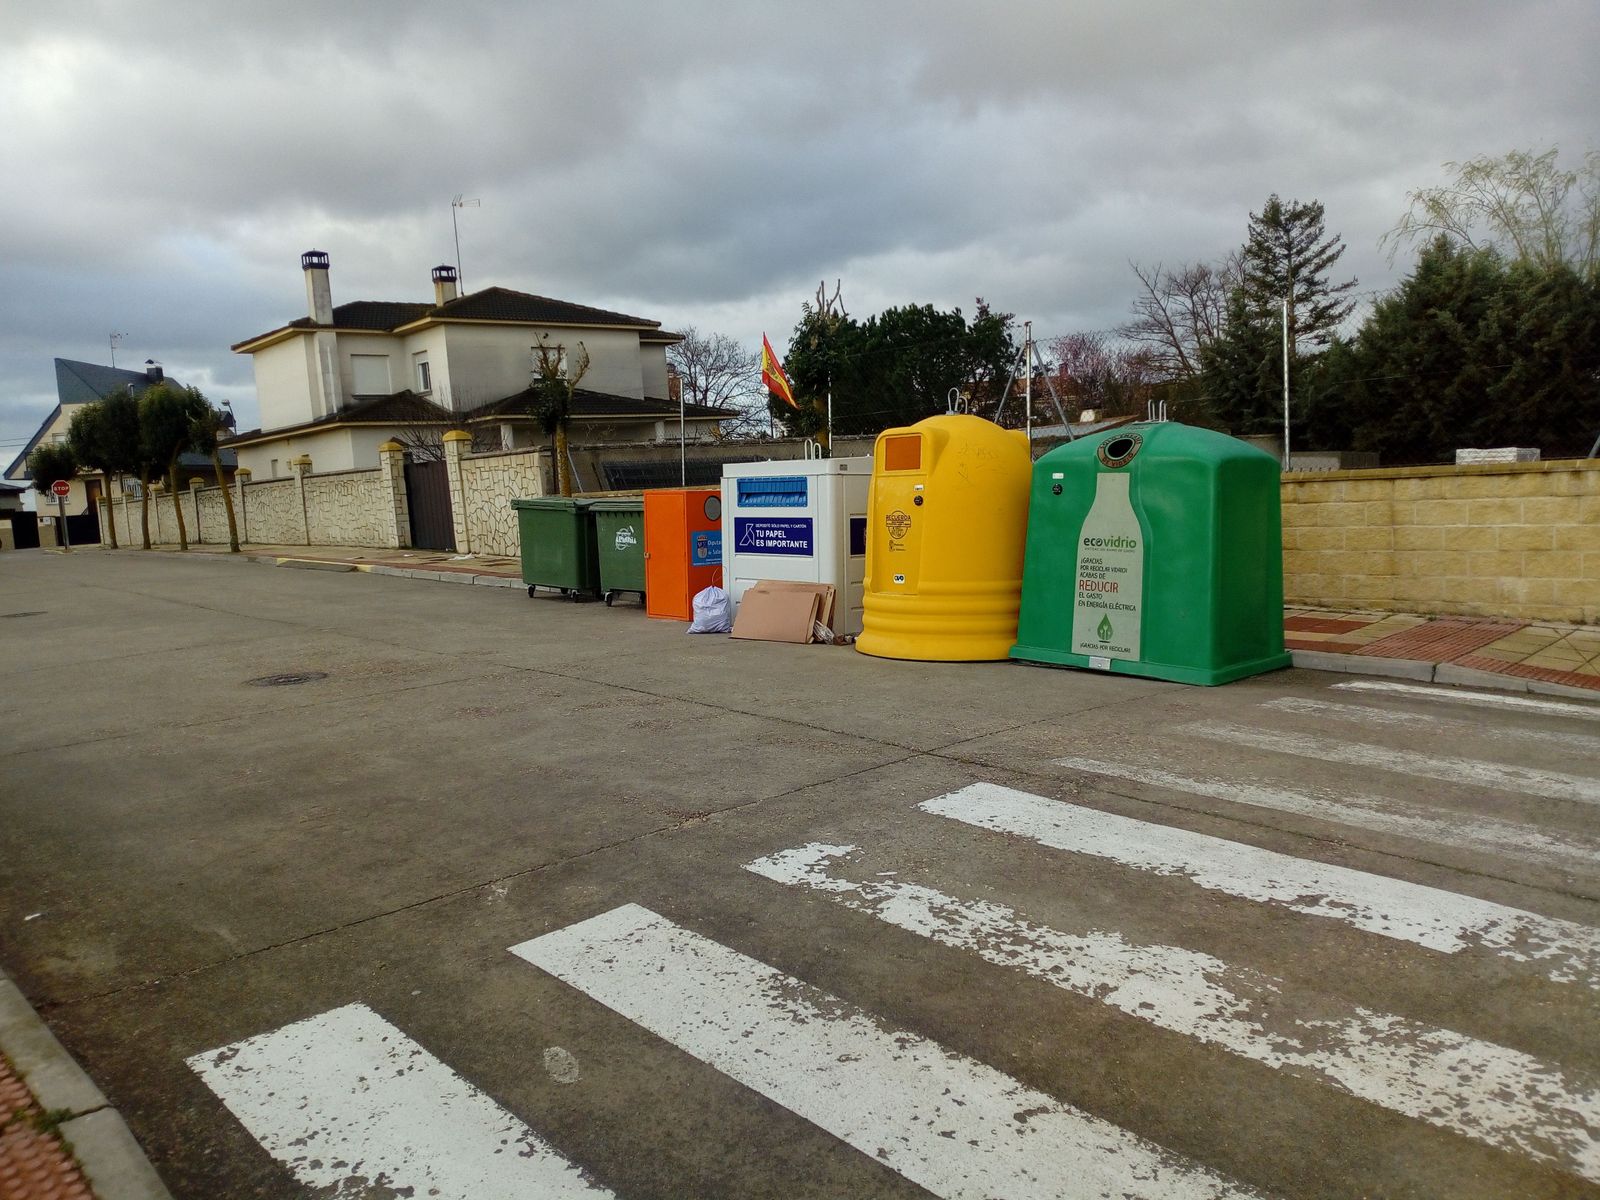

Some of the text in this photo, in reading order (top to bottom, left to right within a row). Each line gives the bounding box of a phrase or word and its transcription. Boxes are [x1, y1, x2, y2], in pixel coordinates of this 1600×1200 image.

[766, 530, 786, 538] PAPEL
[766, 540, 808, 548] IMPORTANTE
[1084, 535, 1137, 548] ecovidrio
[1079, 580, 1118, 593] REDUCIR
[1086, 600, 1108, 609] ENERGÍA
[1108, 602, 1136, 611] ELÉCTRICA
